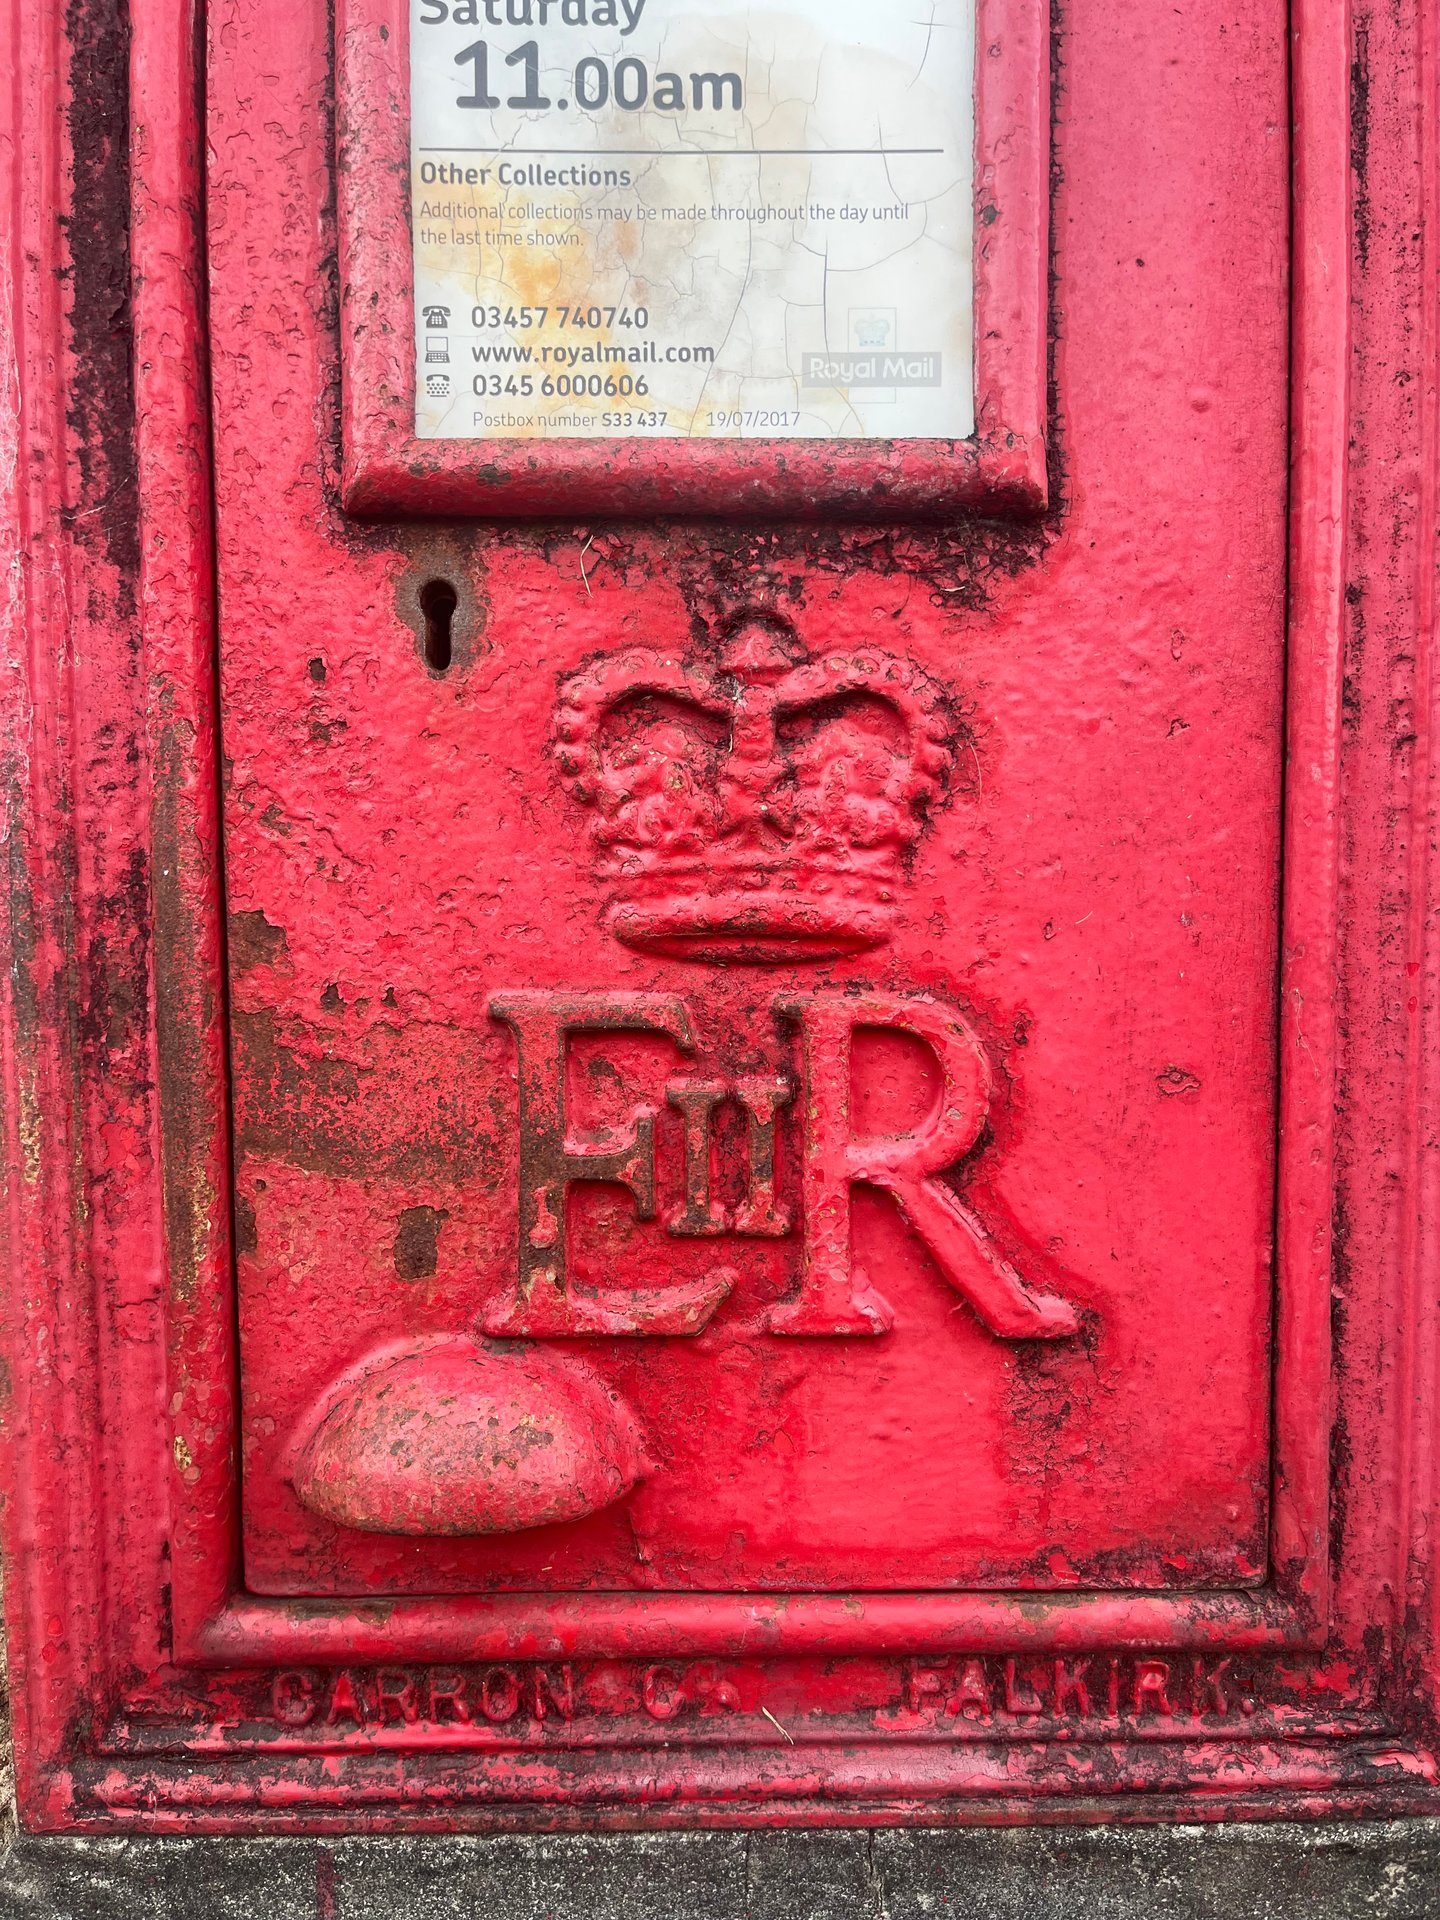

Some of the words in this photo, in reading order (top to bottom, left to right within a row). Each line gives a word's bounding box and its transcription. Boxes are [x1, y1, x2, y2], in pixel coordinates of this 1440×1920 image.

[419, 0, 646, 36] Saturday
[454, 40, 743, 111] 11.00am
[420, 161, 491, 186] Other
[499, 163, 631, 187] Collections
[420, 201, 503, 219] Additional
[508, 202, 592, 220] collections
[597, 206, 632, 221] may
[636, 204, 657, 220] be
[661, 204, 706, 220] made
[711, 204, 805, 223] throughout
[809, 204, 836, 220] the
[839, 204, 868, 223] day
[872, 203, 909, 220] until
[420, 229, 447, 245] the
[451, 229, 480, 246] last
[485, 229, 522, 246] time
[526, 230, 584, 247] shown.
[471, 306, 548, 329] 03457
[555, 307, 649, 329] 740740
[471, 341, 715, 367] www.royalmail.com
[810, 358, 876, 383] Royal
[882, 358, 934, 379] Mail
[472, 374, 533, 396] 0345
[540, 374, 649, 397] 6000606
[473, 411, 533, 427] Postbox
[537, 411, 598, 427] number
[601, 413, 632, 427] S33
[637, 412, 668, 427] 437
[706, 411, 801, 427] 19/07/2017
[273, 1664, 574, 1727] CARRON
